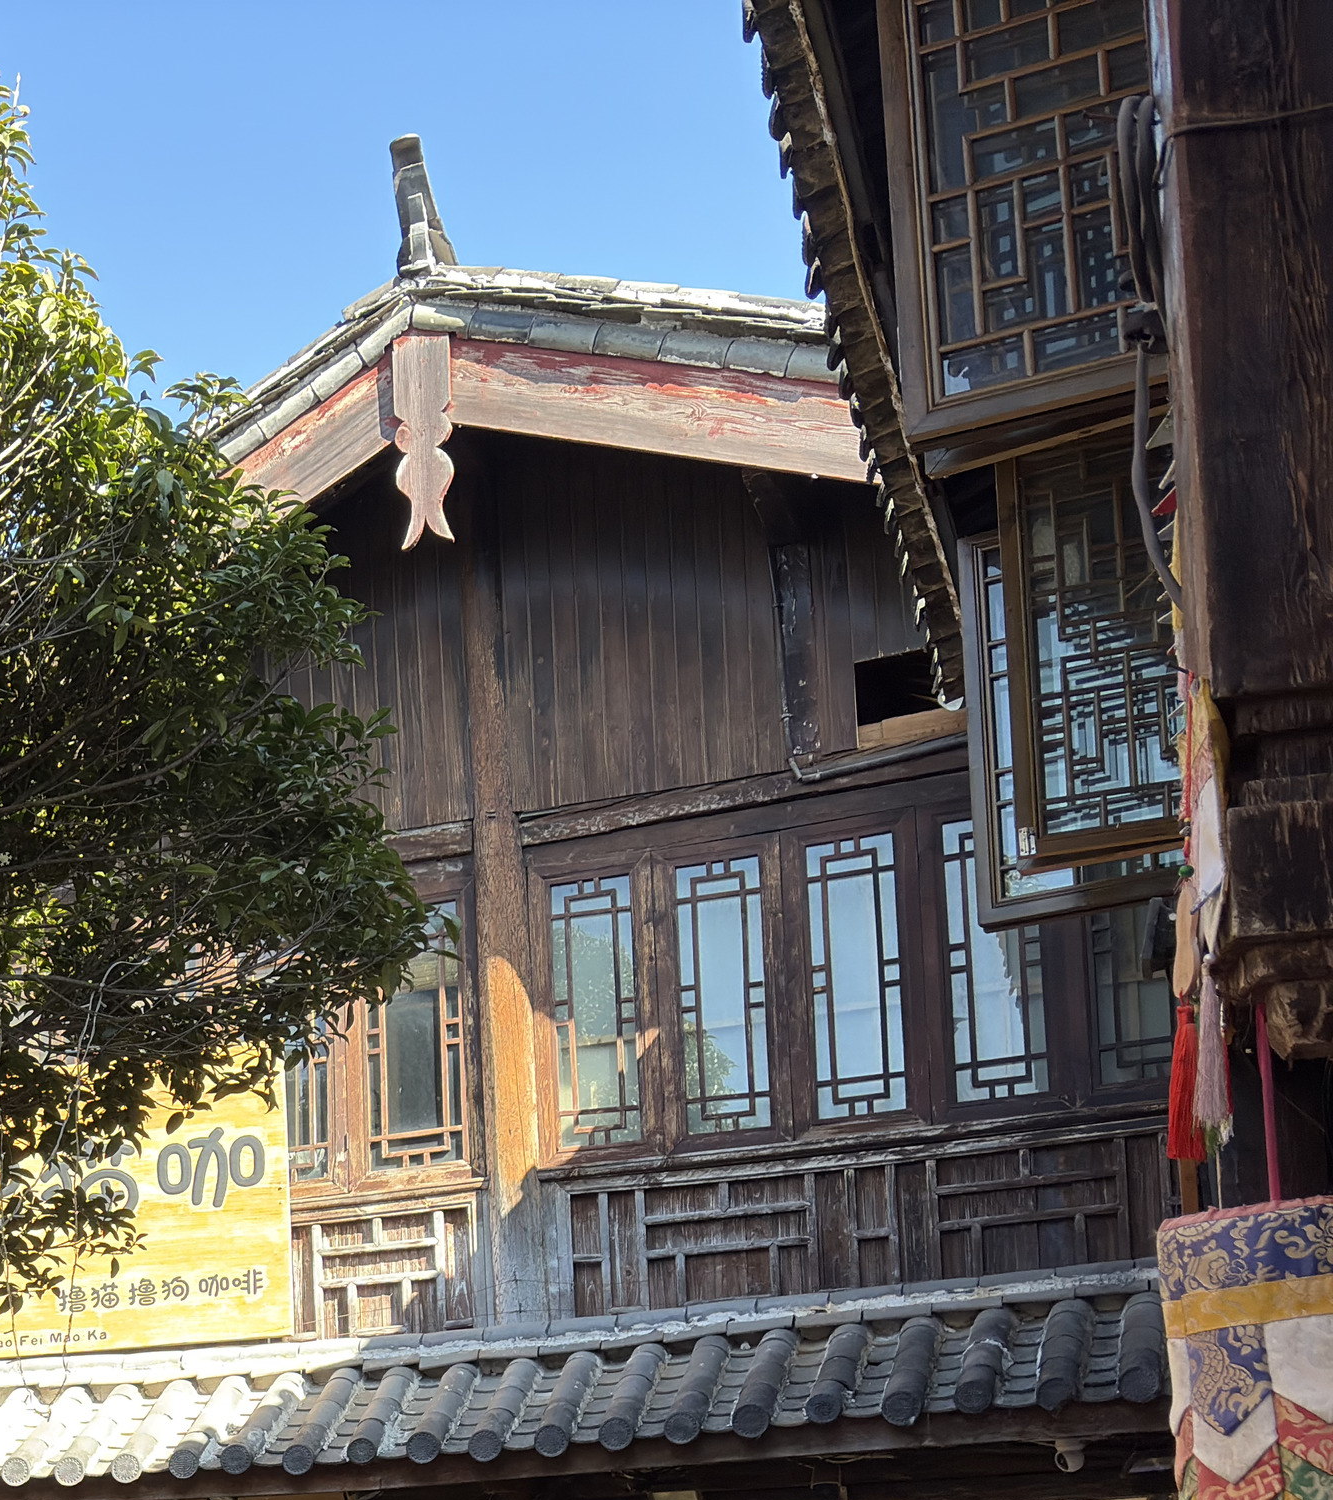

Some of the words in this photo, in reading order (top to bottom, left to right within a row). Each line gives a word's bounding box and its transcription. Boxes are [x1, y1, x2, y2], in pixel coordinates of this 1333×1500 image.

[198, 1268, 264, 1298] 咖啡
[19, 1334, 44, 1347] Fei
[49, 1332, 81, 1345] Mao
[87, 1329, 108, 1342] Ka
